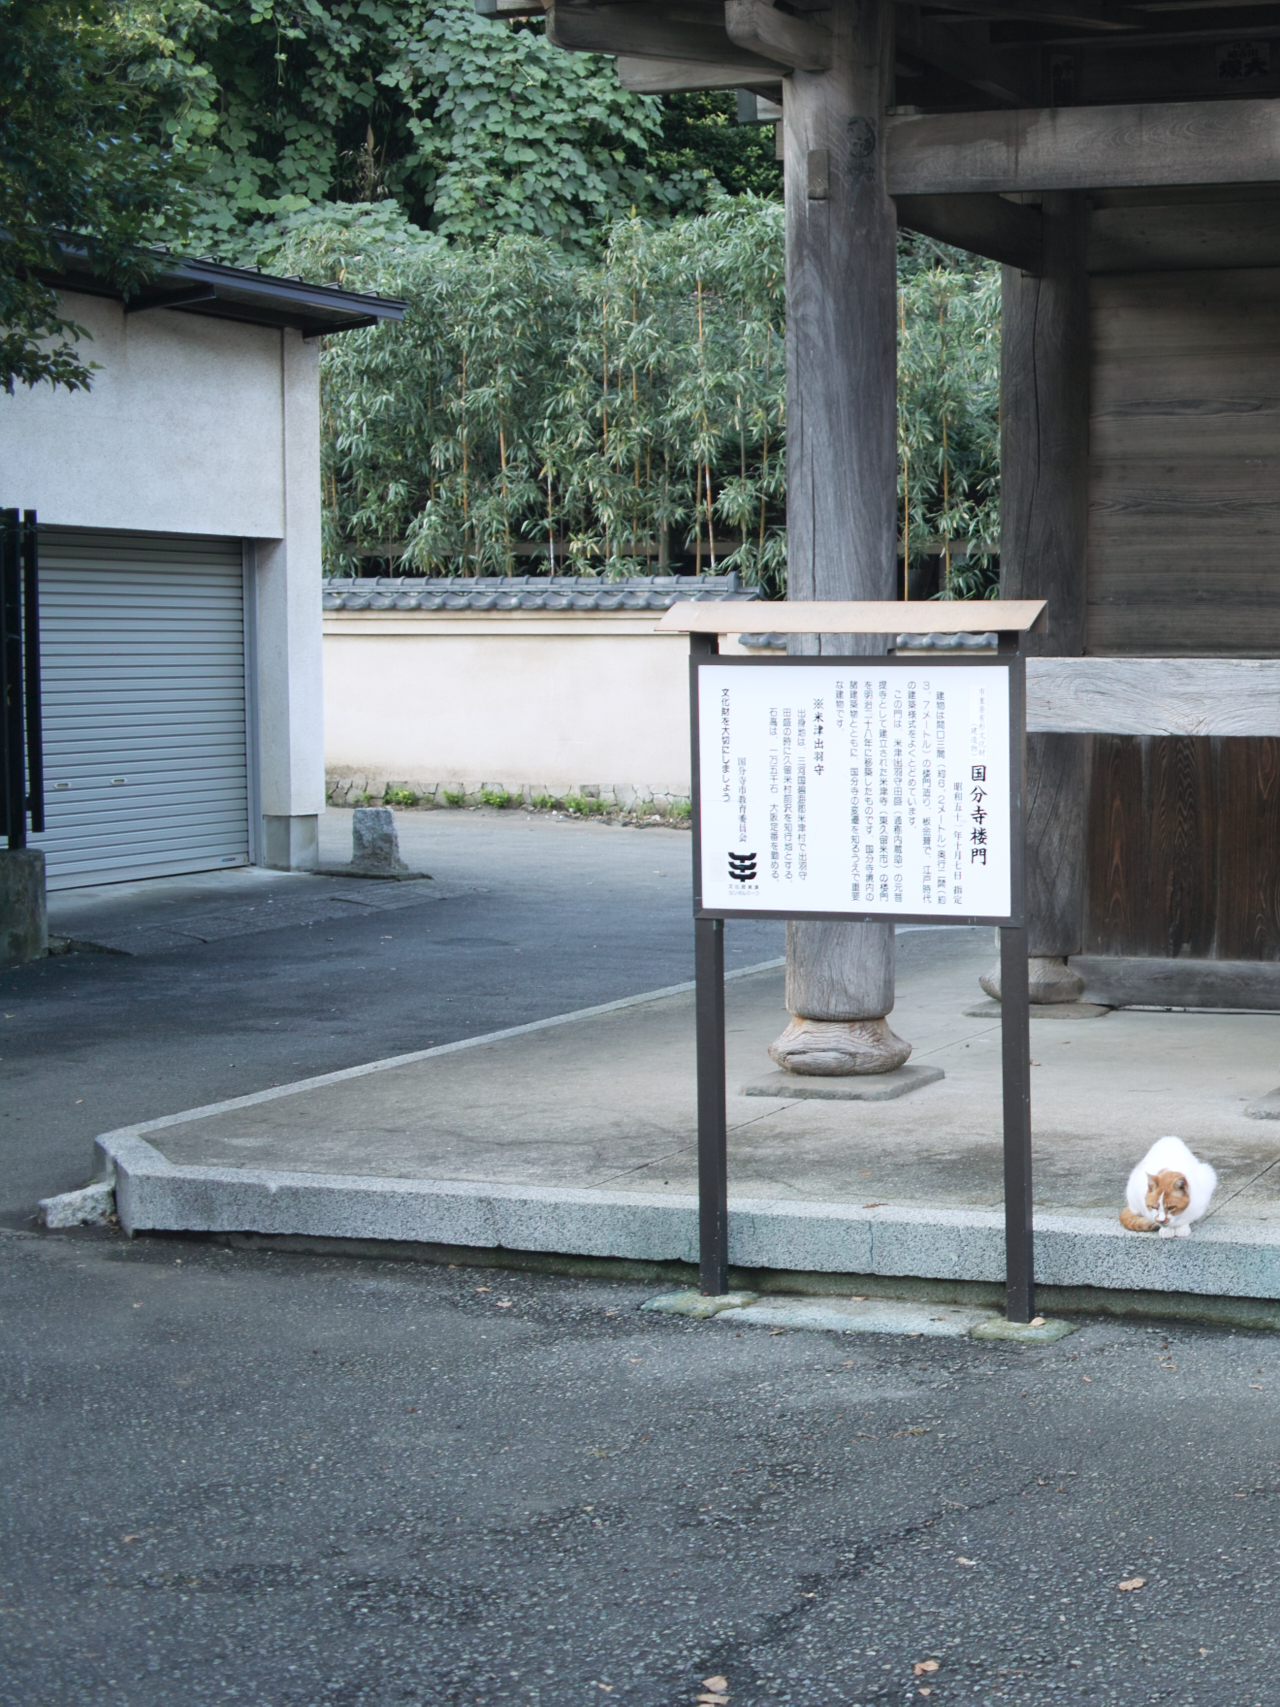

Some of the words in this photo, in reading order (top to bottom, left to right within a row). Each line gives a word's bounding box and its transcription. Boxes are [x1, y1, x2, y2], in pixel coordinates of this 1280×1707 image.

[721, 688, 731, 803] 文化財を大切にしましょう
[737, 757, 747, 843] 国分寺市教育委員会
[970, 764, 988, 866] 国分寺楼門
